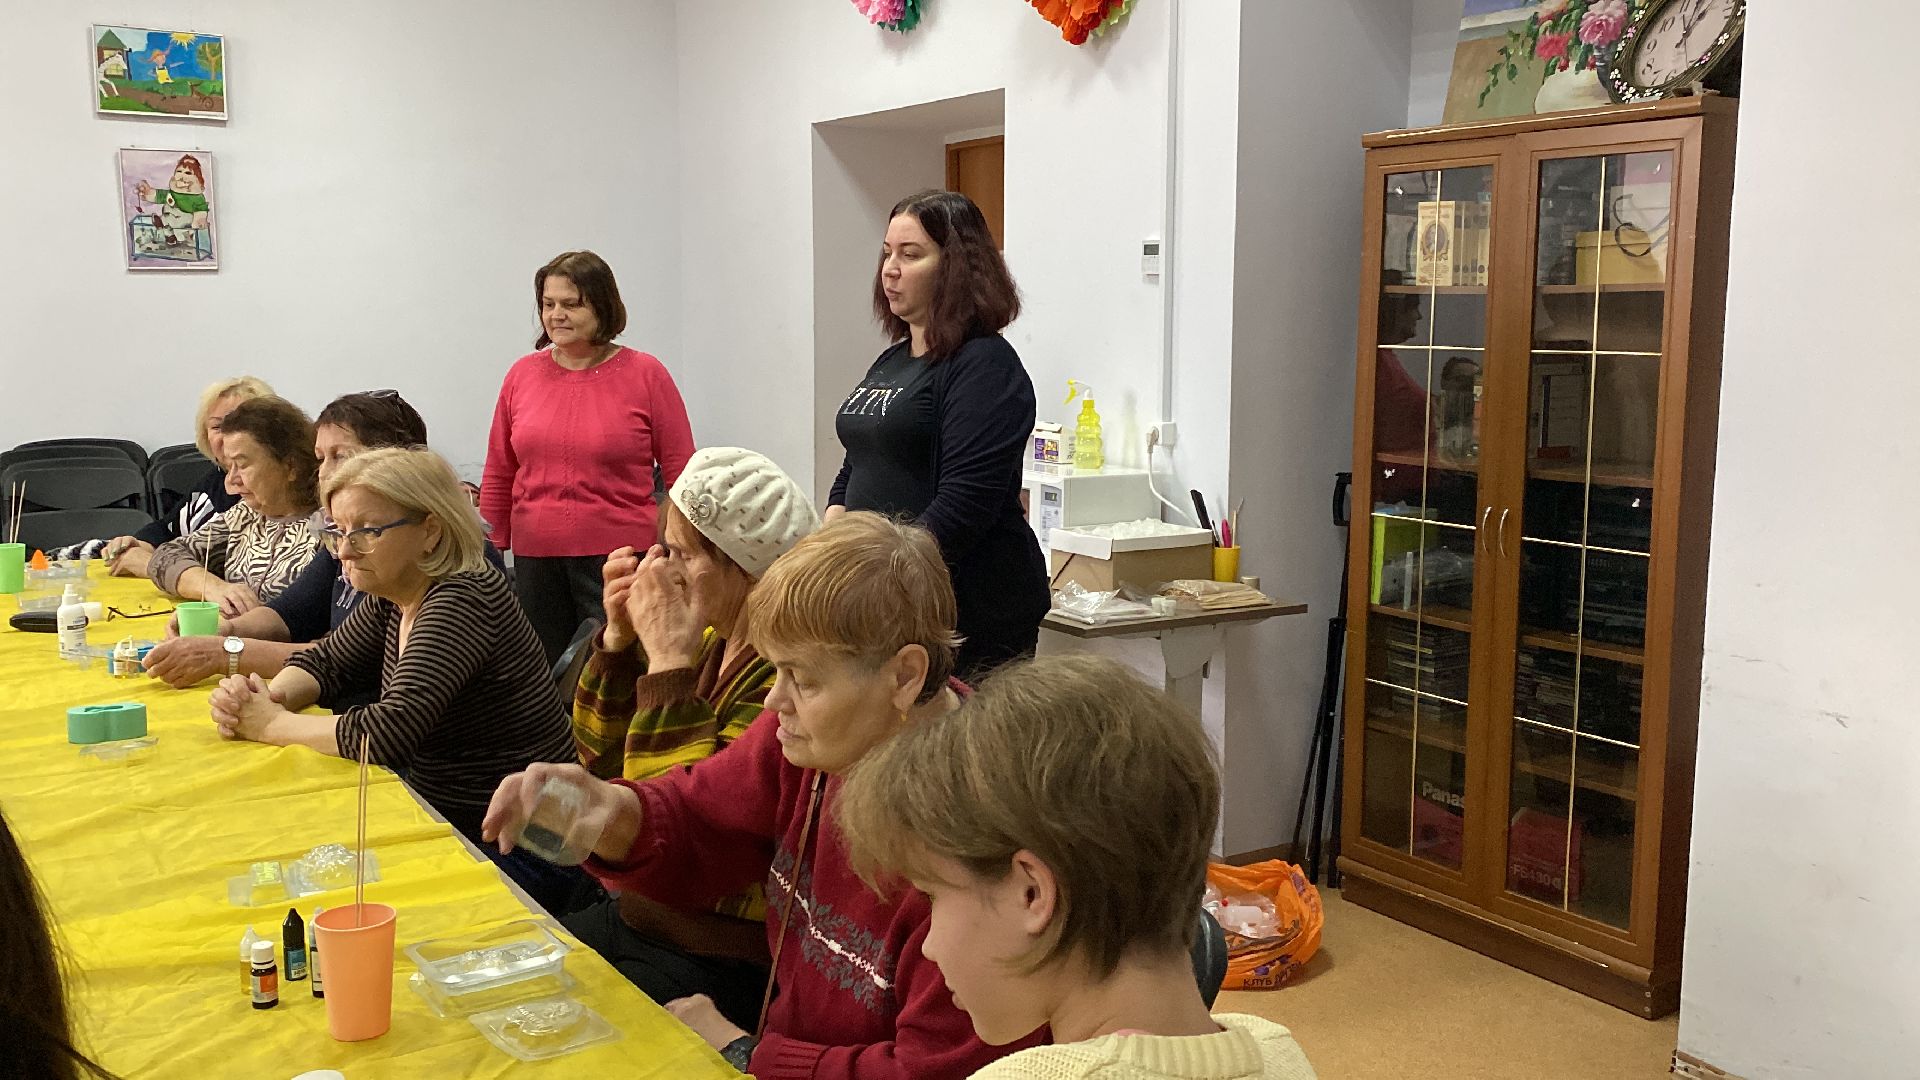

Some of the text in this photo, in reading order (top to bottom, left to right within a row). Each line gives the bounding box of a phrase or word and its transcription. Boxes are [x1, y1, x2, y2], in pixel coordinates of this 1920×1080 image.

[1659, 16, 1675, 34] 10
[1646, 39, 1658, 55] 9
[1641, 58, 1655, 76] 8
[1651, 69, 1664, 86] 7
